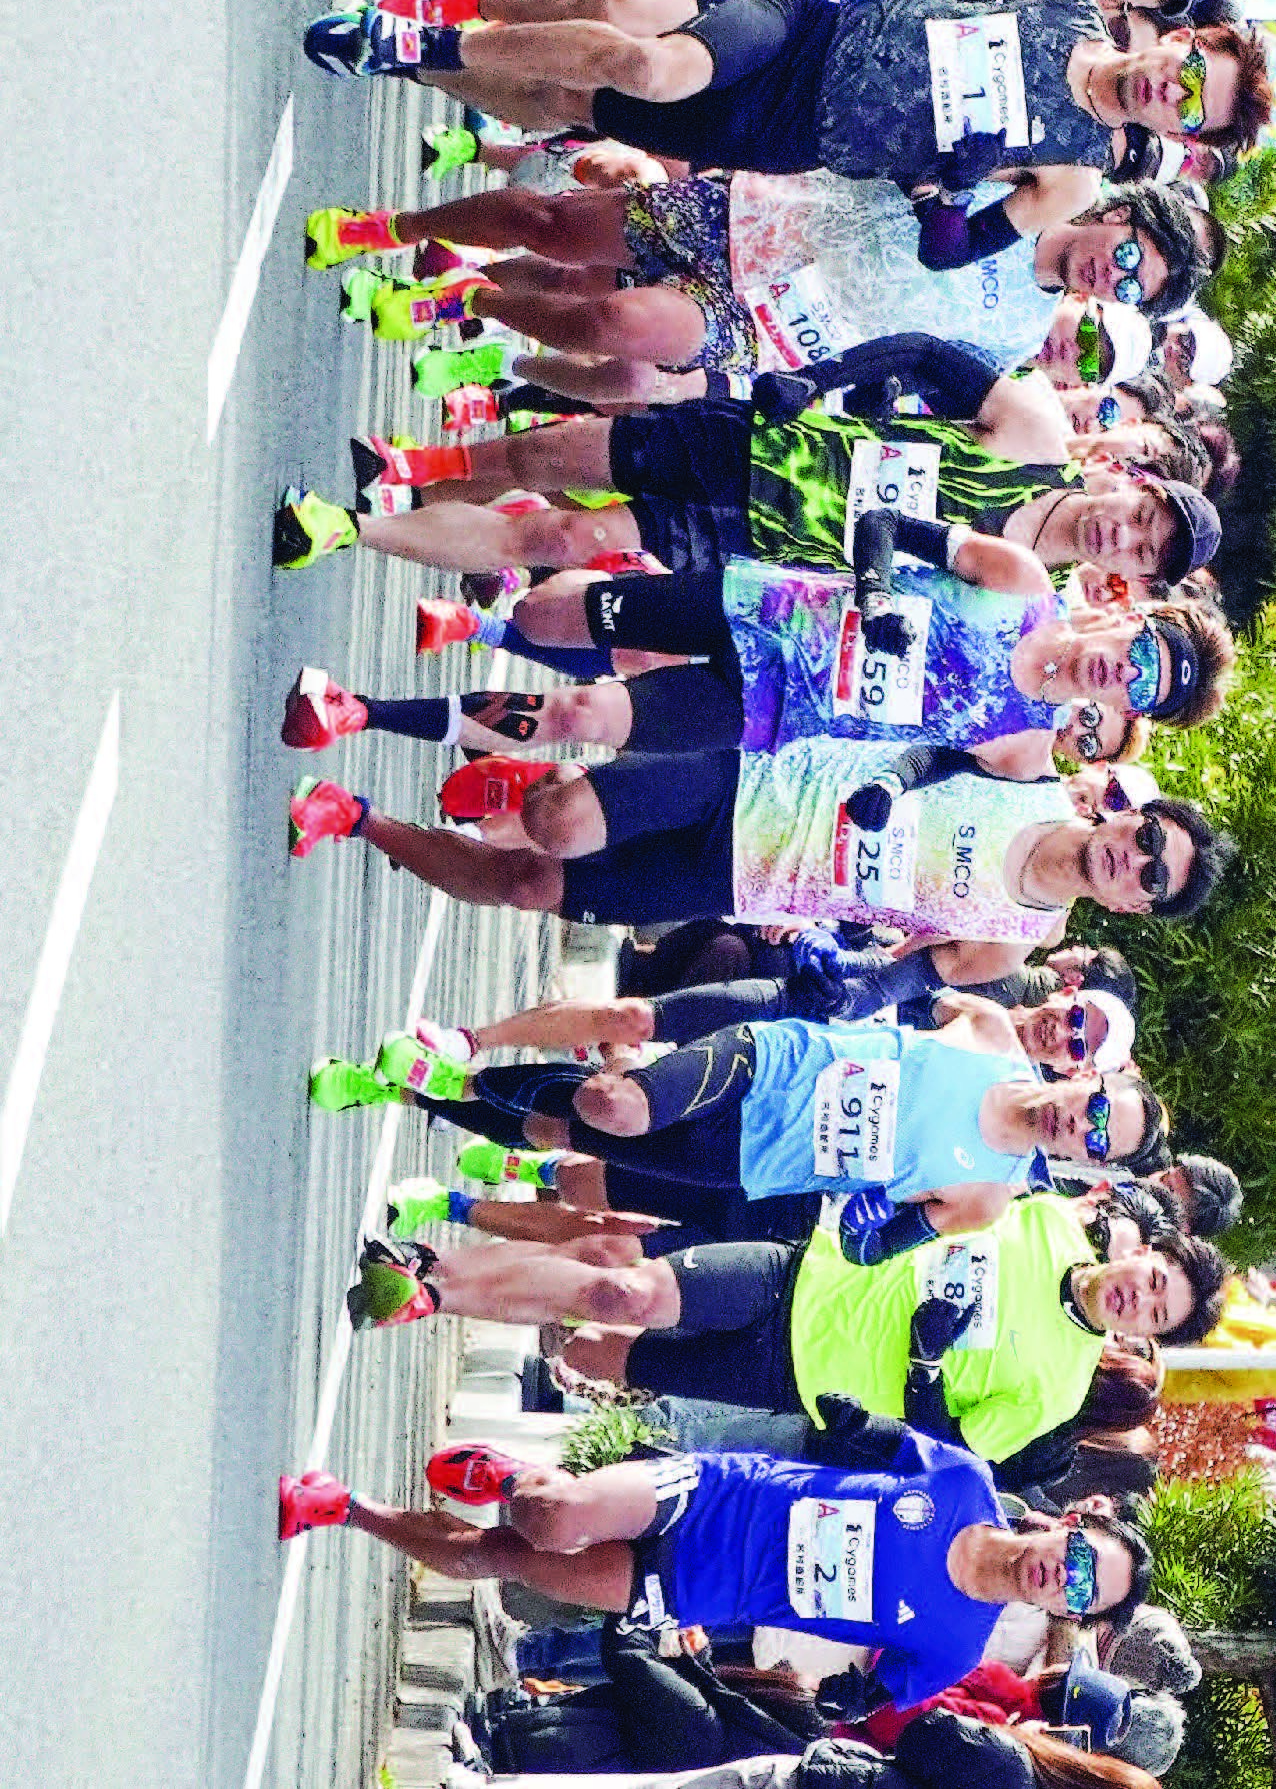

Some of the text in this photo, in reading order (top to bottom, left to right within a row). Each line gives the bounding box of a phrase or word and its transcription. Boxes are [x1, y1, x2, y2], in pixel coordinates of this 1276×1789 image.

[954, 24, 986, 100] A 1
[992, 52, 1009, 124] Cygames
[981, 259, 999, 309] MCO
[788, 312, 831, 362] 108
[876, 445, 902, 504] A 9
[860, 657, 887, 707] 59
[855, 838, 881, 883] 25
[836, 1062, 866, 1159] A 911
[868, 1095, 884, 1162] Cygames
[943, 1282, 965, 1300] 8
[814, 1502, 841, 1583] A 2
[845, 1537, 860, 1603] Cygames
